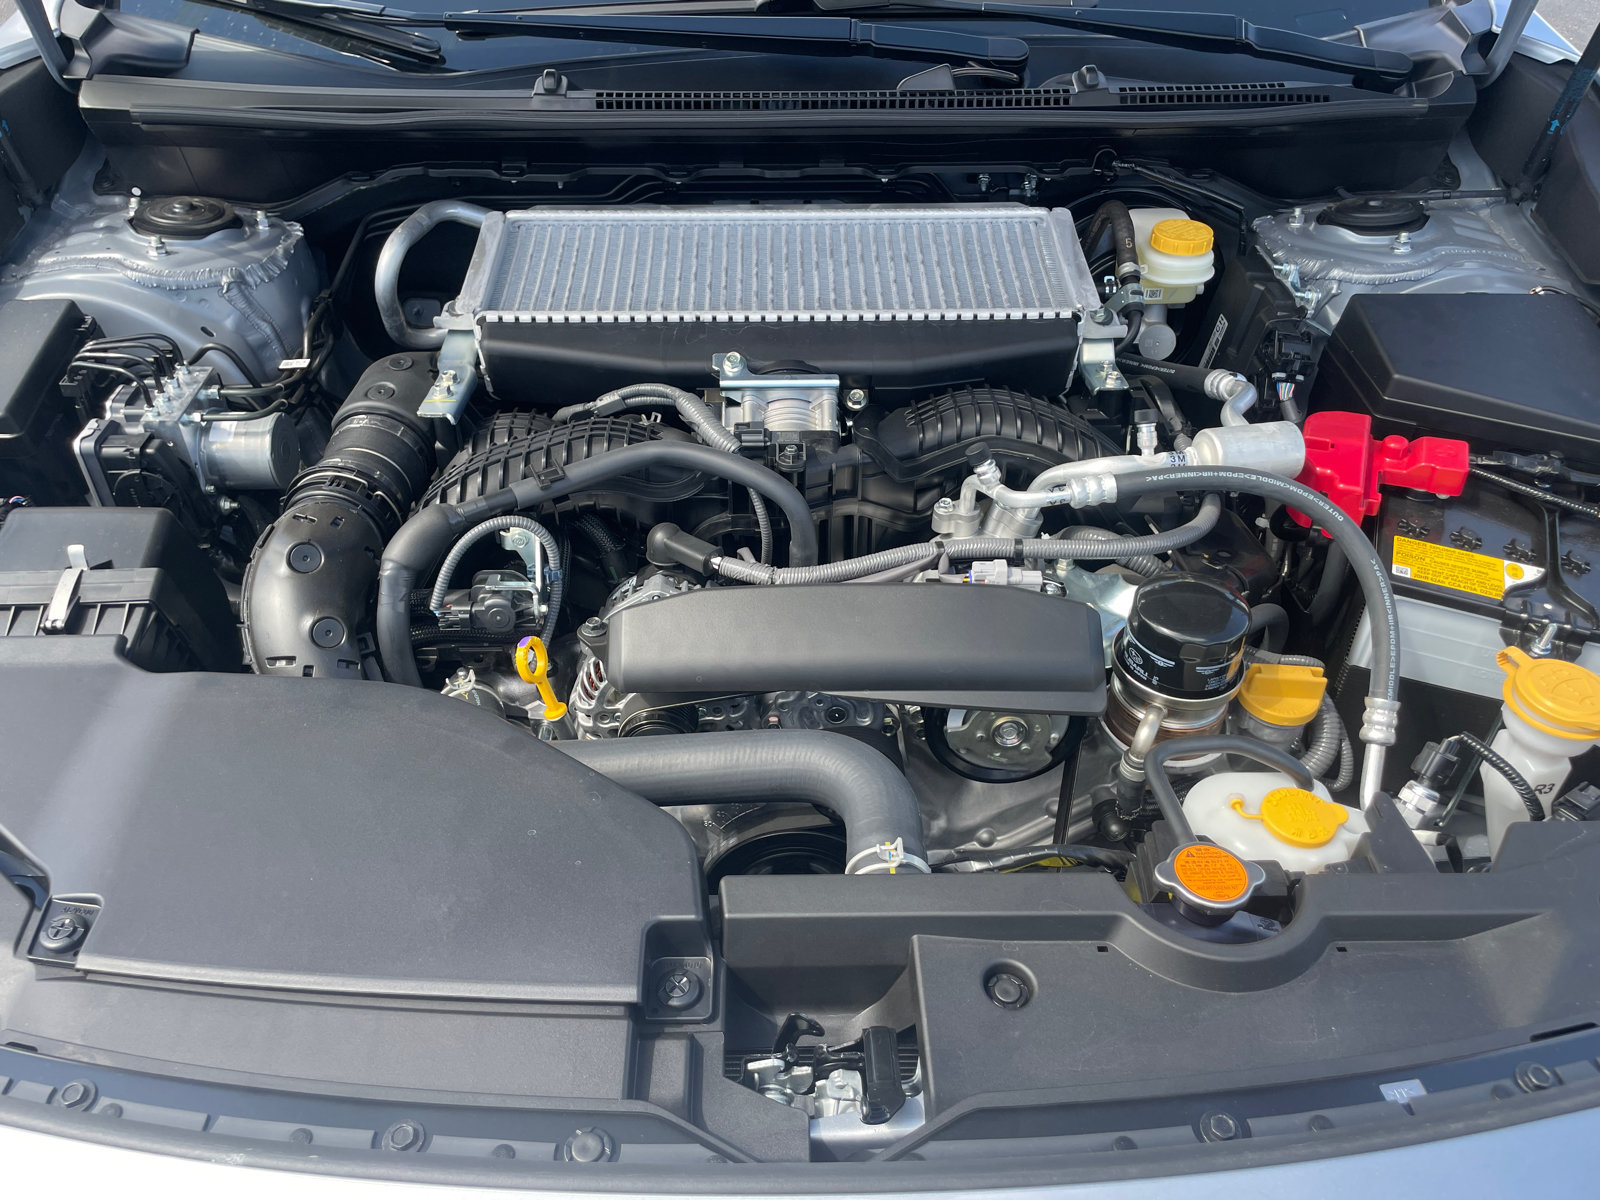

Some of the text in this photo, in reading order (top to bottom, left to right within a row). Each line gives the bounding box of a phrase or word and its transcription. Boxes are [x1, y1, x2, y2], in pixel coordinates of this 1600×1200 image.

[1125, 237, 1133, 249] 5
[1396, 537, 1427, 547] DANGER
[1395, 550, 1425, 561] POISON
